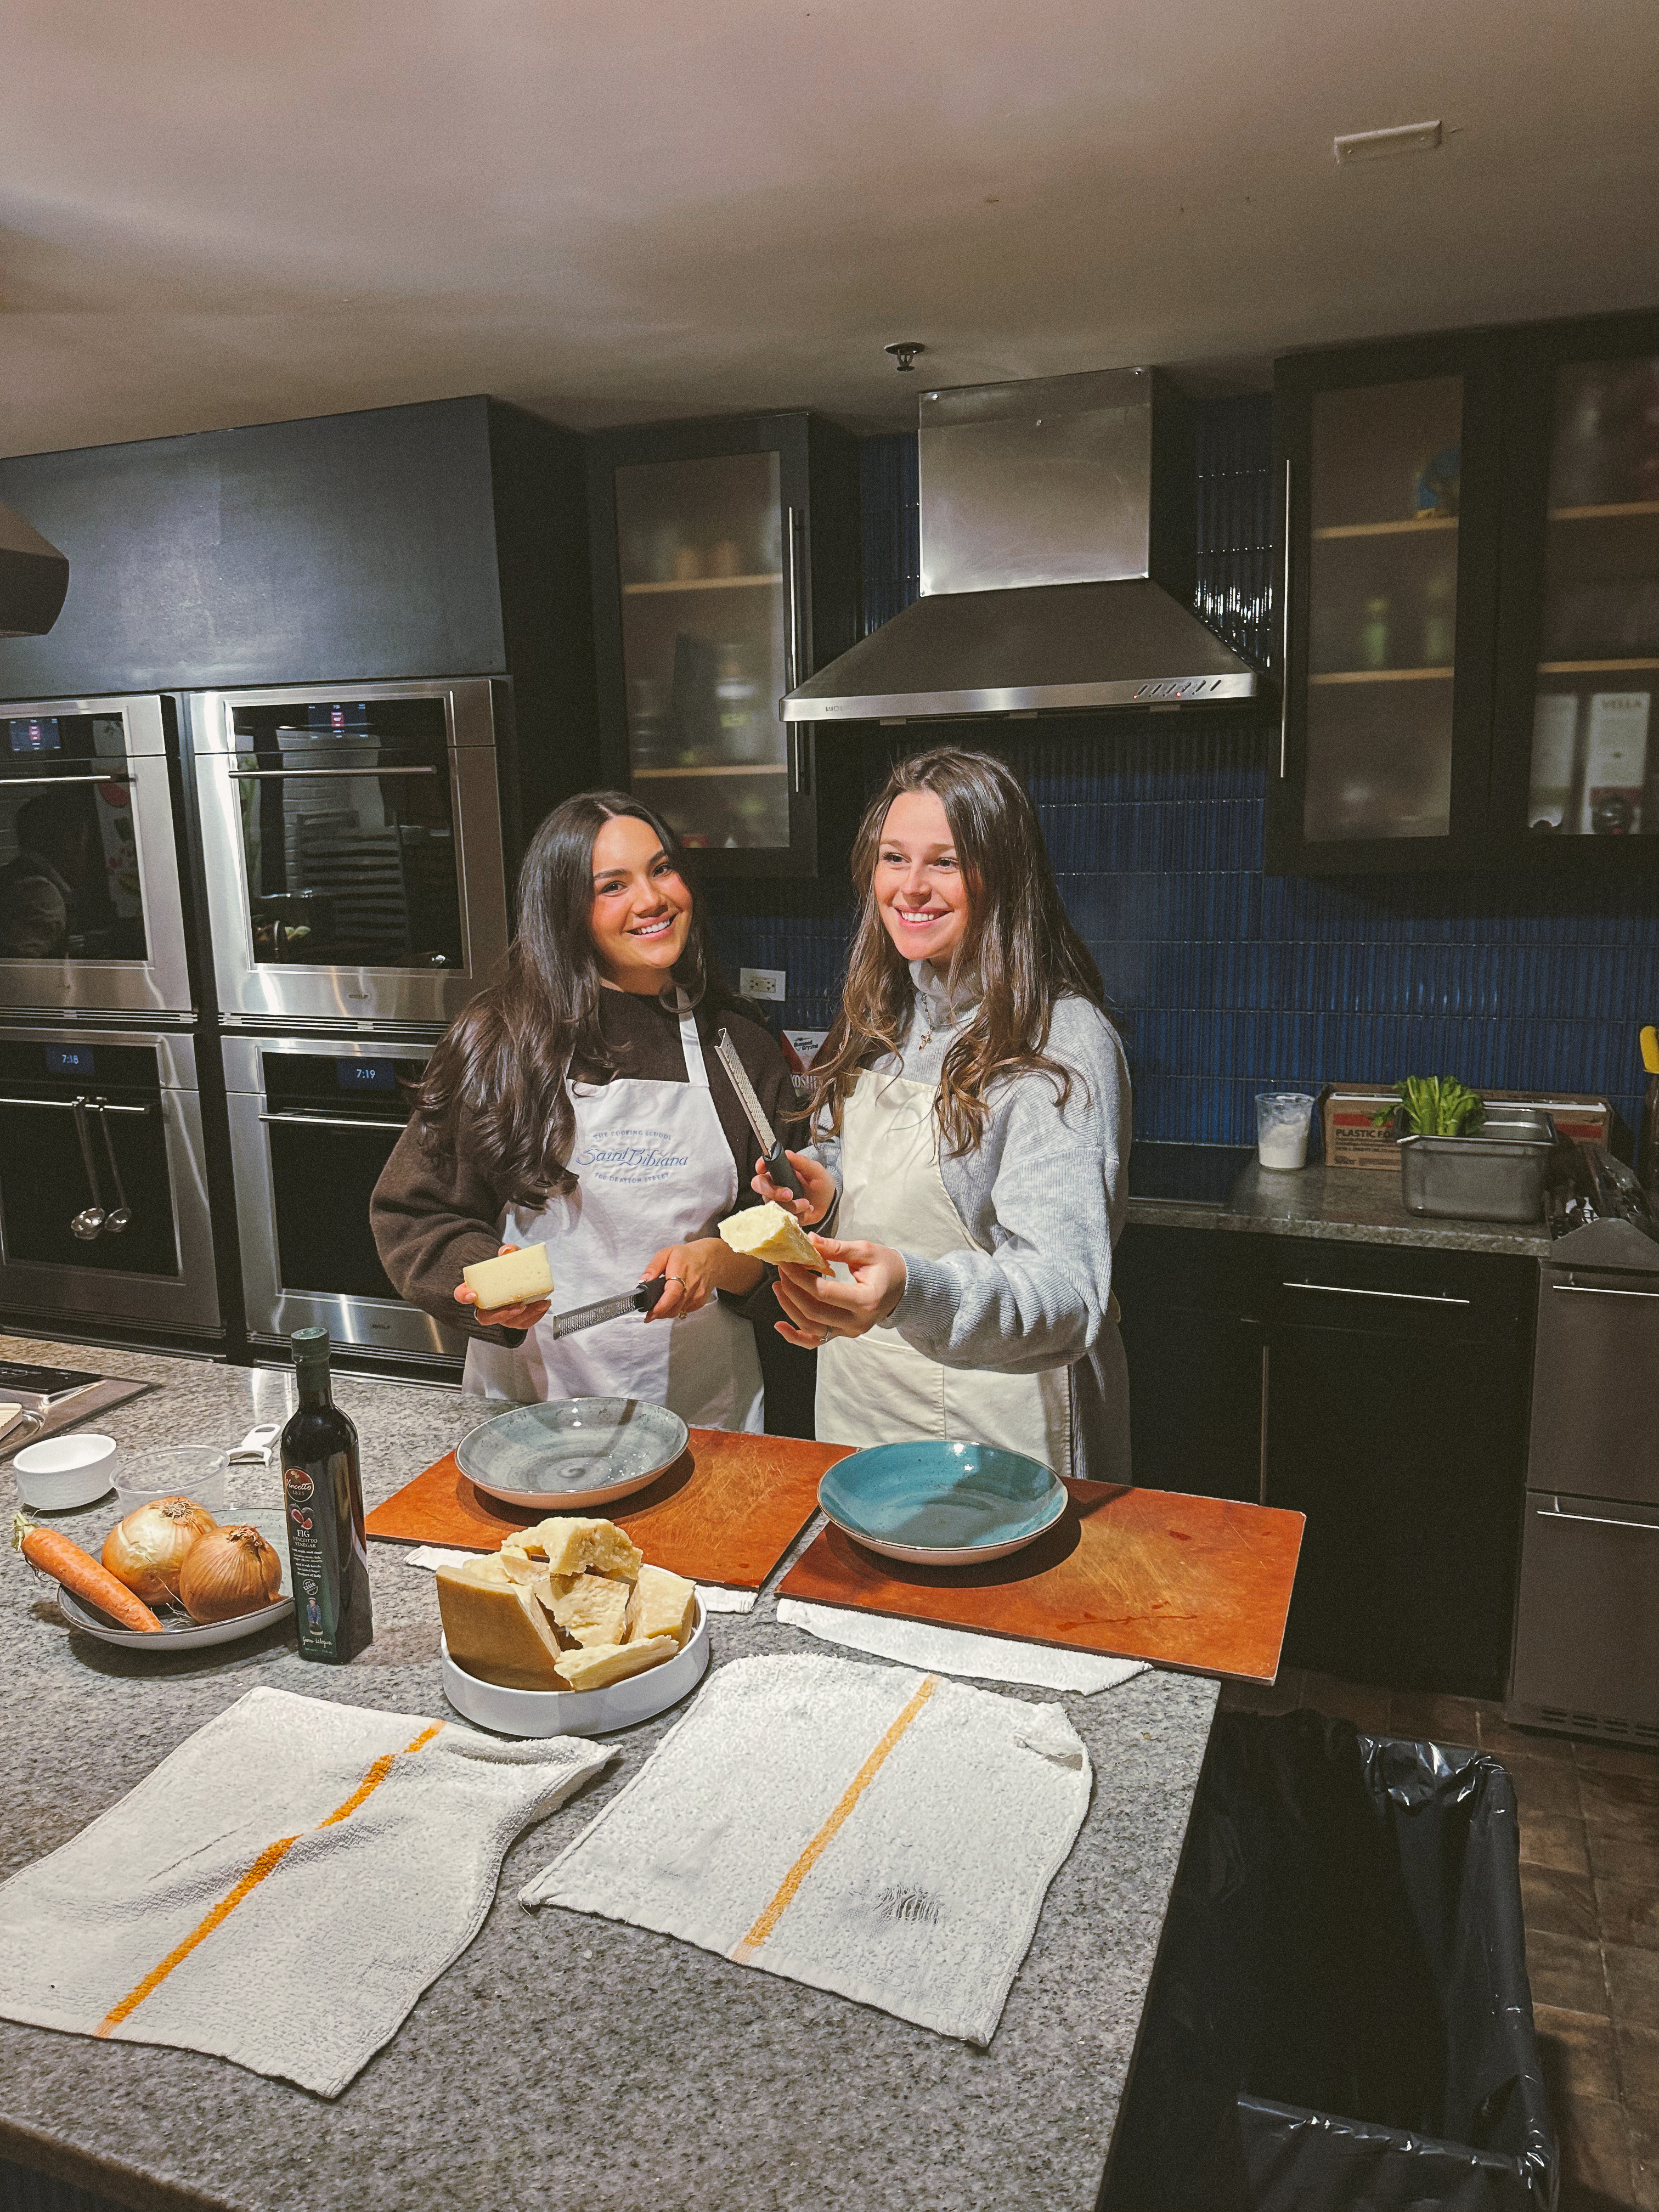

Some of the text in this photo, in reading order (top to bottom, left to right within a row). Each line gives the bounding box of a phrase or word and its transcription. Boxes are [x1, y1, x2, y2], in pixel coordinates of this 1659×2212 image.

[61, 1054, 79, 1064] 7:18
[357, 1069, 376, 1079] 7:19
[645, 1130, 672, 1141] SCHOOL
[1335, 1128, 1375, 1137] PLASTIC
[576, 1147, 689, 1167] Saint Bibiana
[286, 1479, 312, 1491] Vincotto
[297, 1529, 310, 1538] FIG
